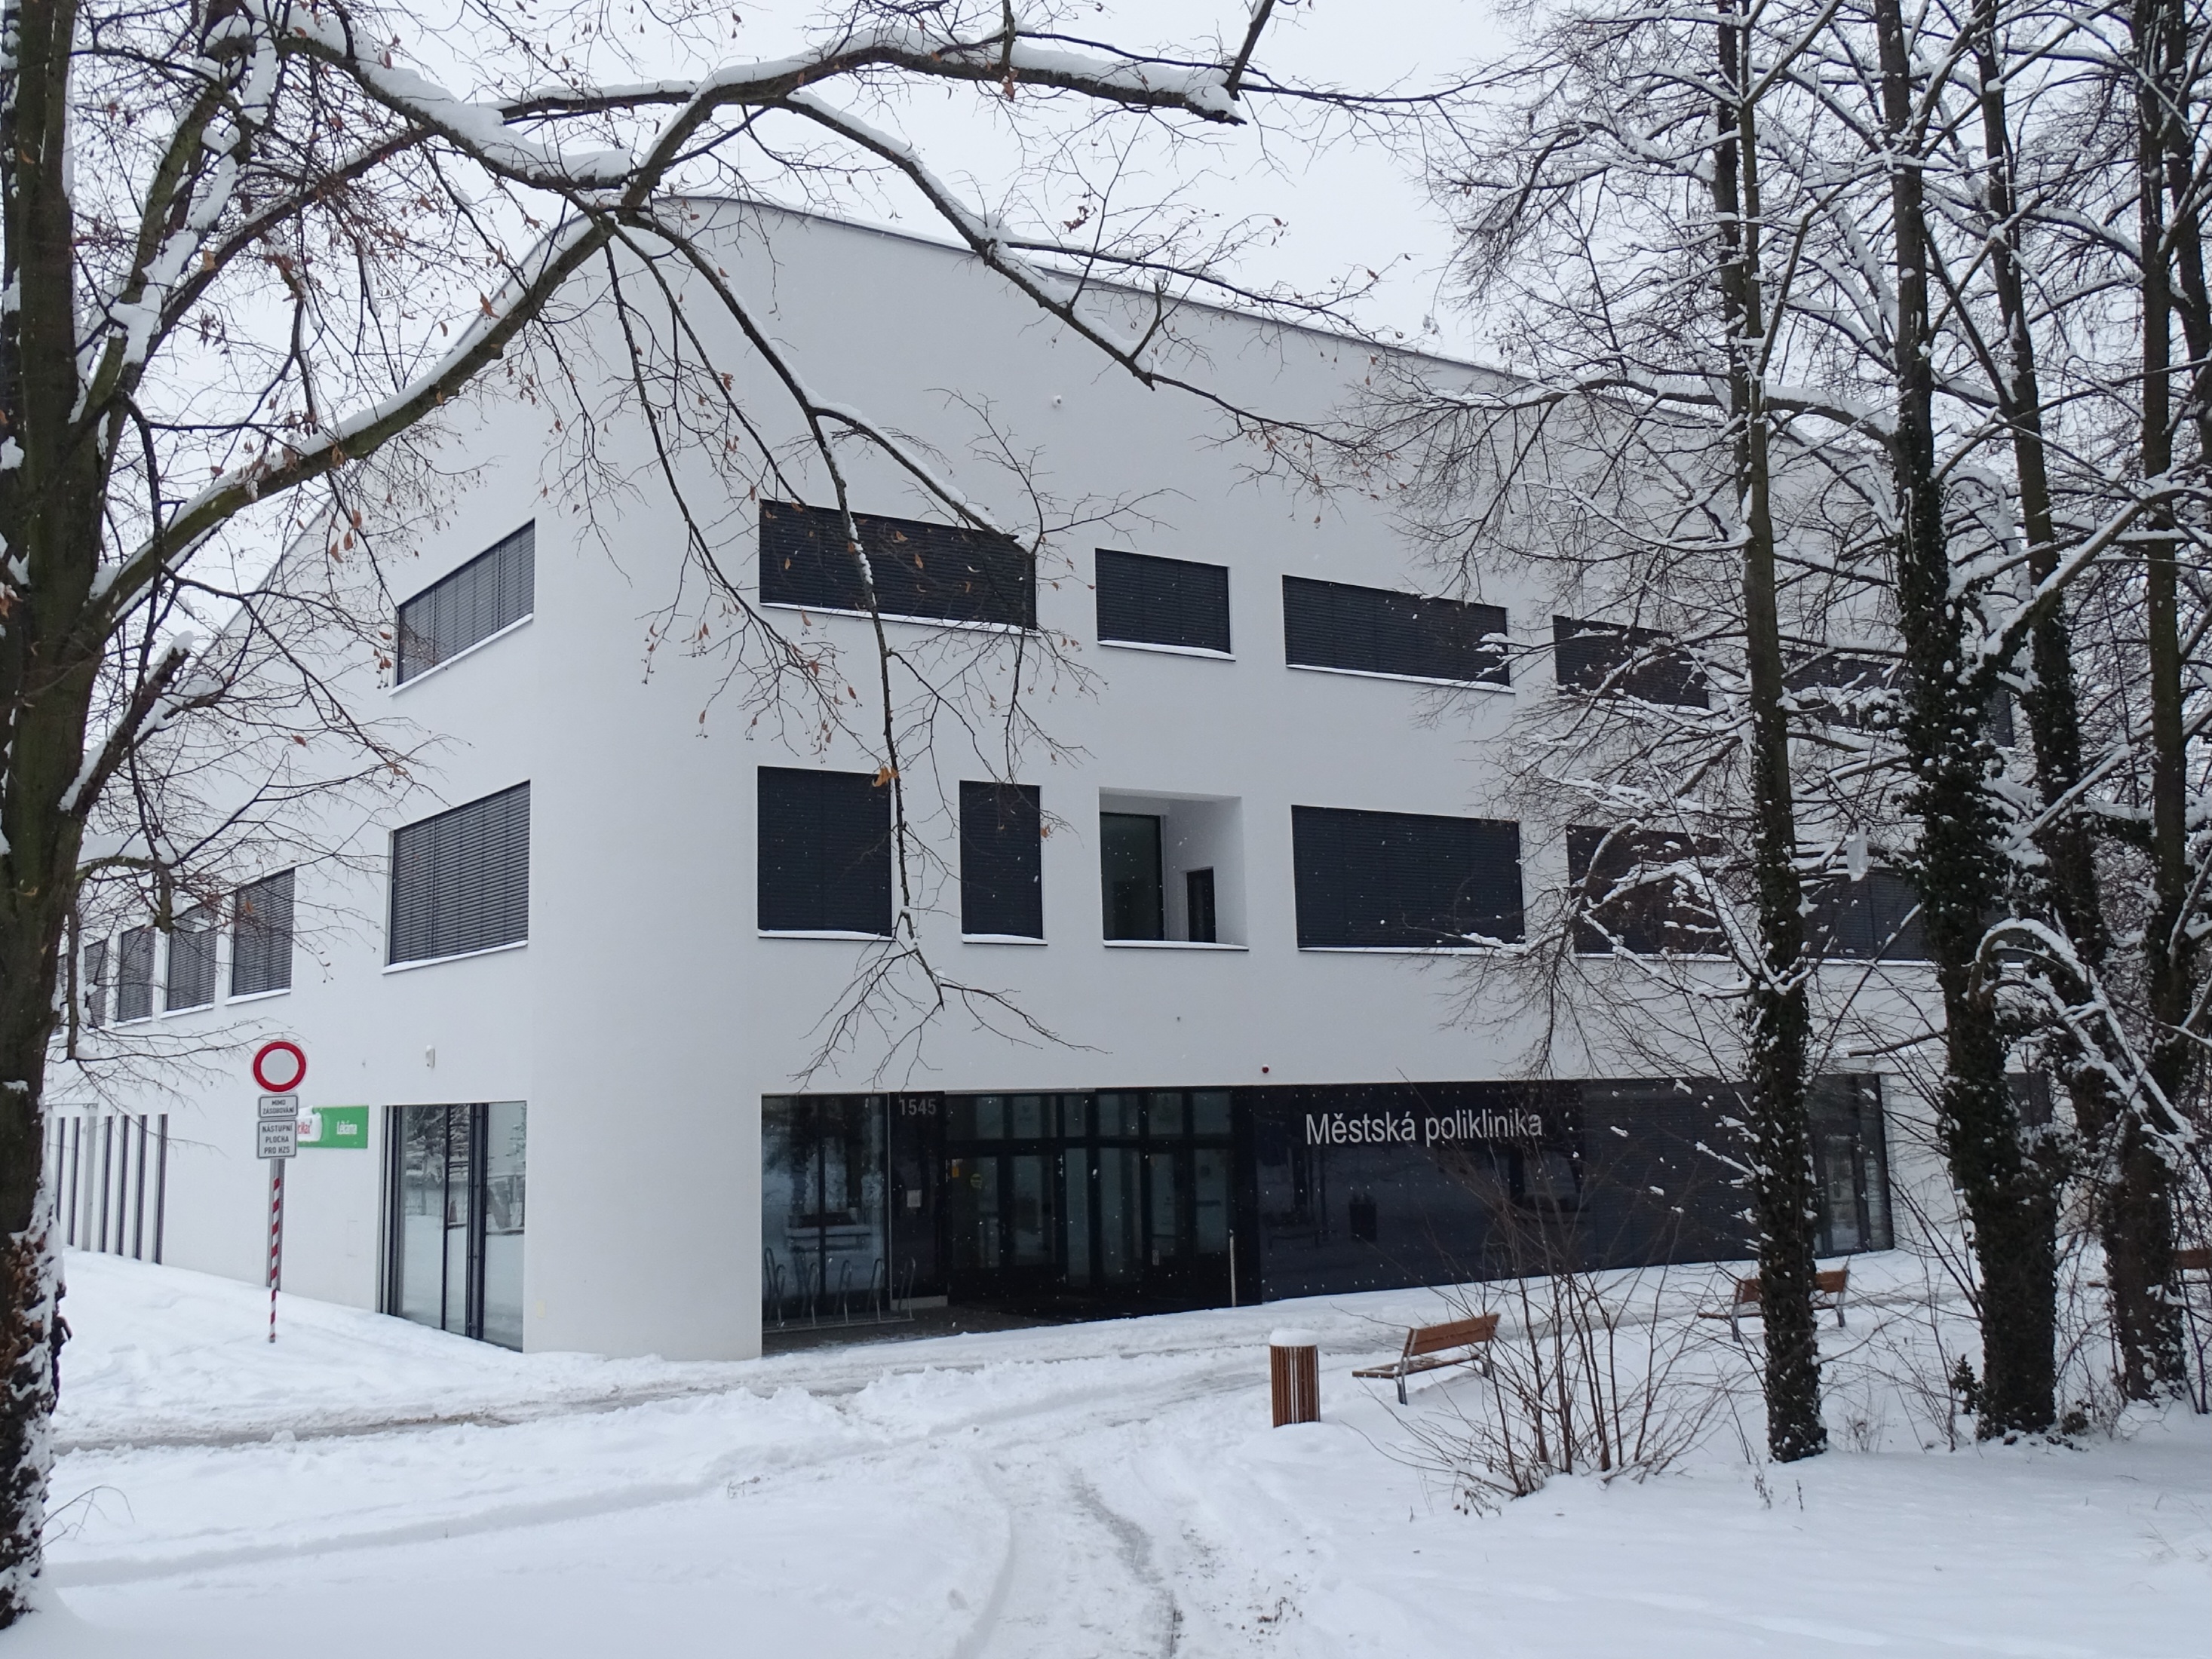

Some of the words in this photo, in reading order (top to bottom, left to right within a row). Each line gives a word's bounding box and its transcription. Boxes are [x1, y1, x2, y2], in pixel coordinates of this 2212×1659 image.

[262, 1105, 294, 1115] ZÁSOBOVÁNÍ
[899, 1099, 937, 1116] 1545
[262, 1123, 293, 1133] NÁSTUPNÍ
[1305, 1111, 1416, 1145] Městská
[1425, 1108, 1543, 1147] poliklinika
